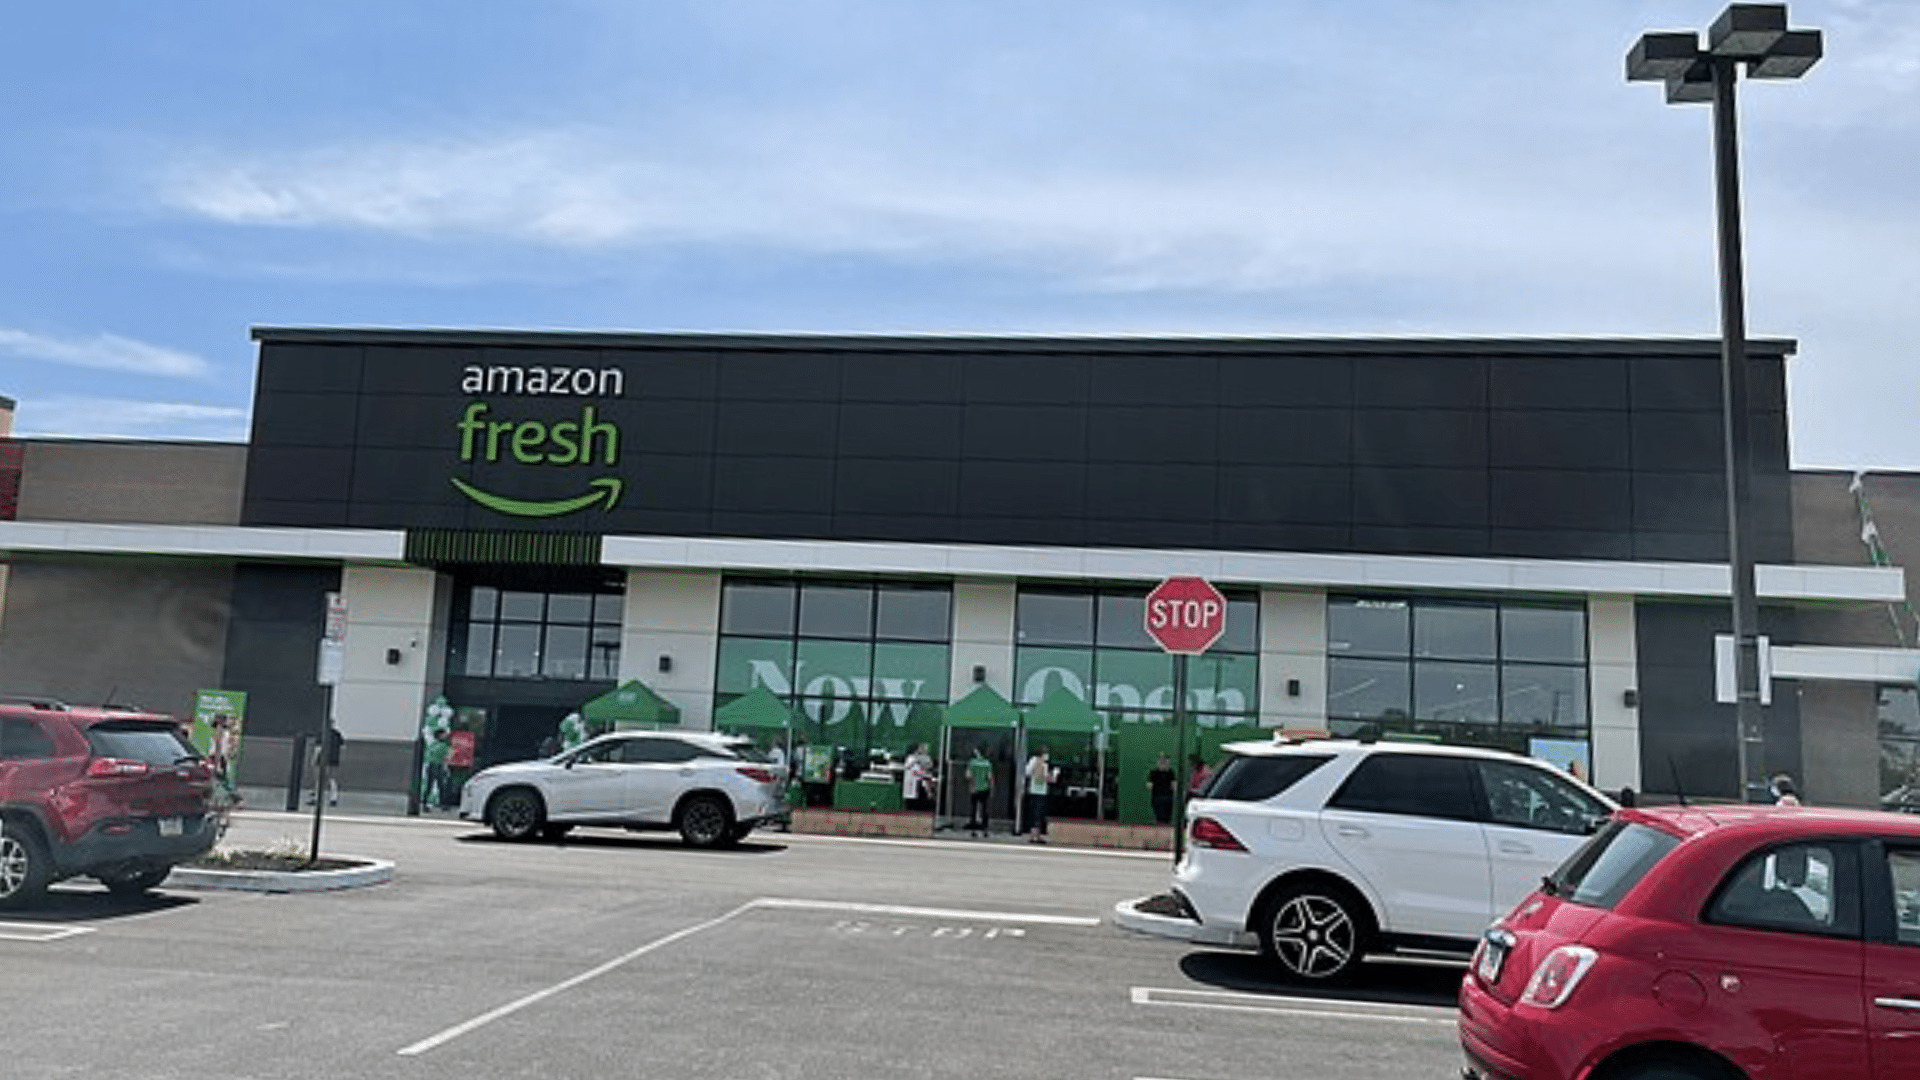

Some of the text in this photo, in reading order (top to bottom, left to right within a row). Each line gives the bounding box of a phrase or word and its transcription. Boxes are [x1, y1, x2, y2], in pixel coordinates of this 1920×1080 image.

[462, 365, 623, 395] amazon
[457, 403, 616, 463] fresh
[1151, 599, 1219, 628] STOP
[748, 659, 926, 727] Now
